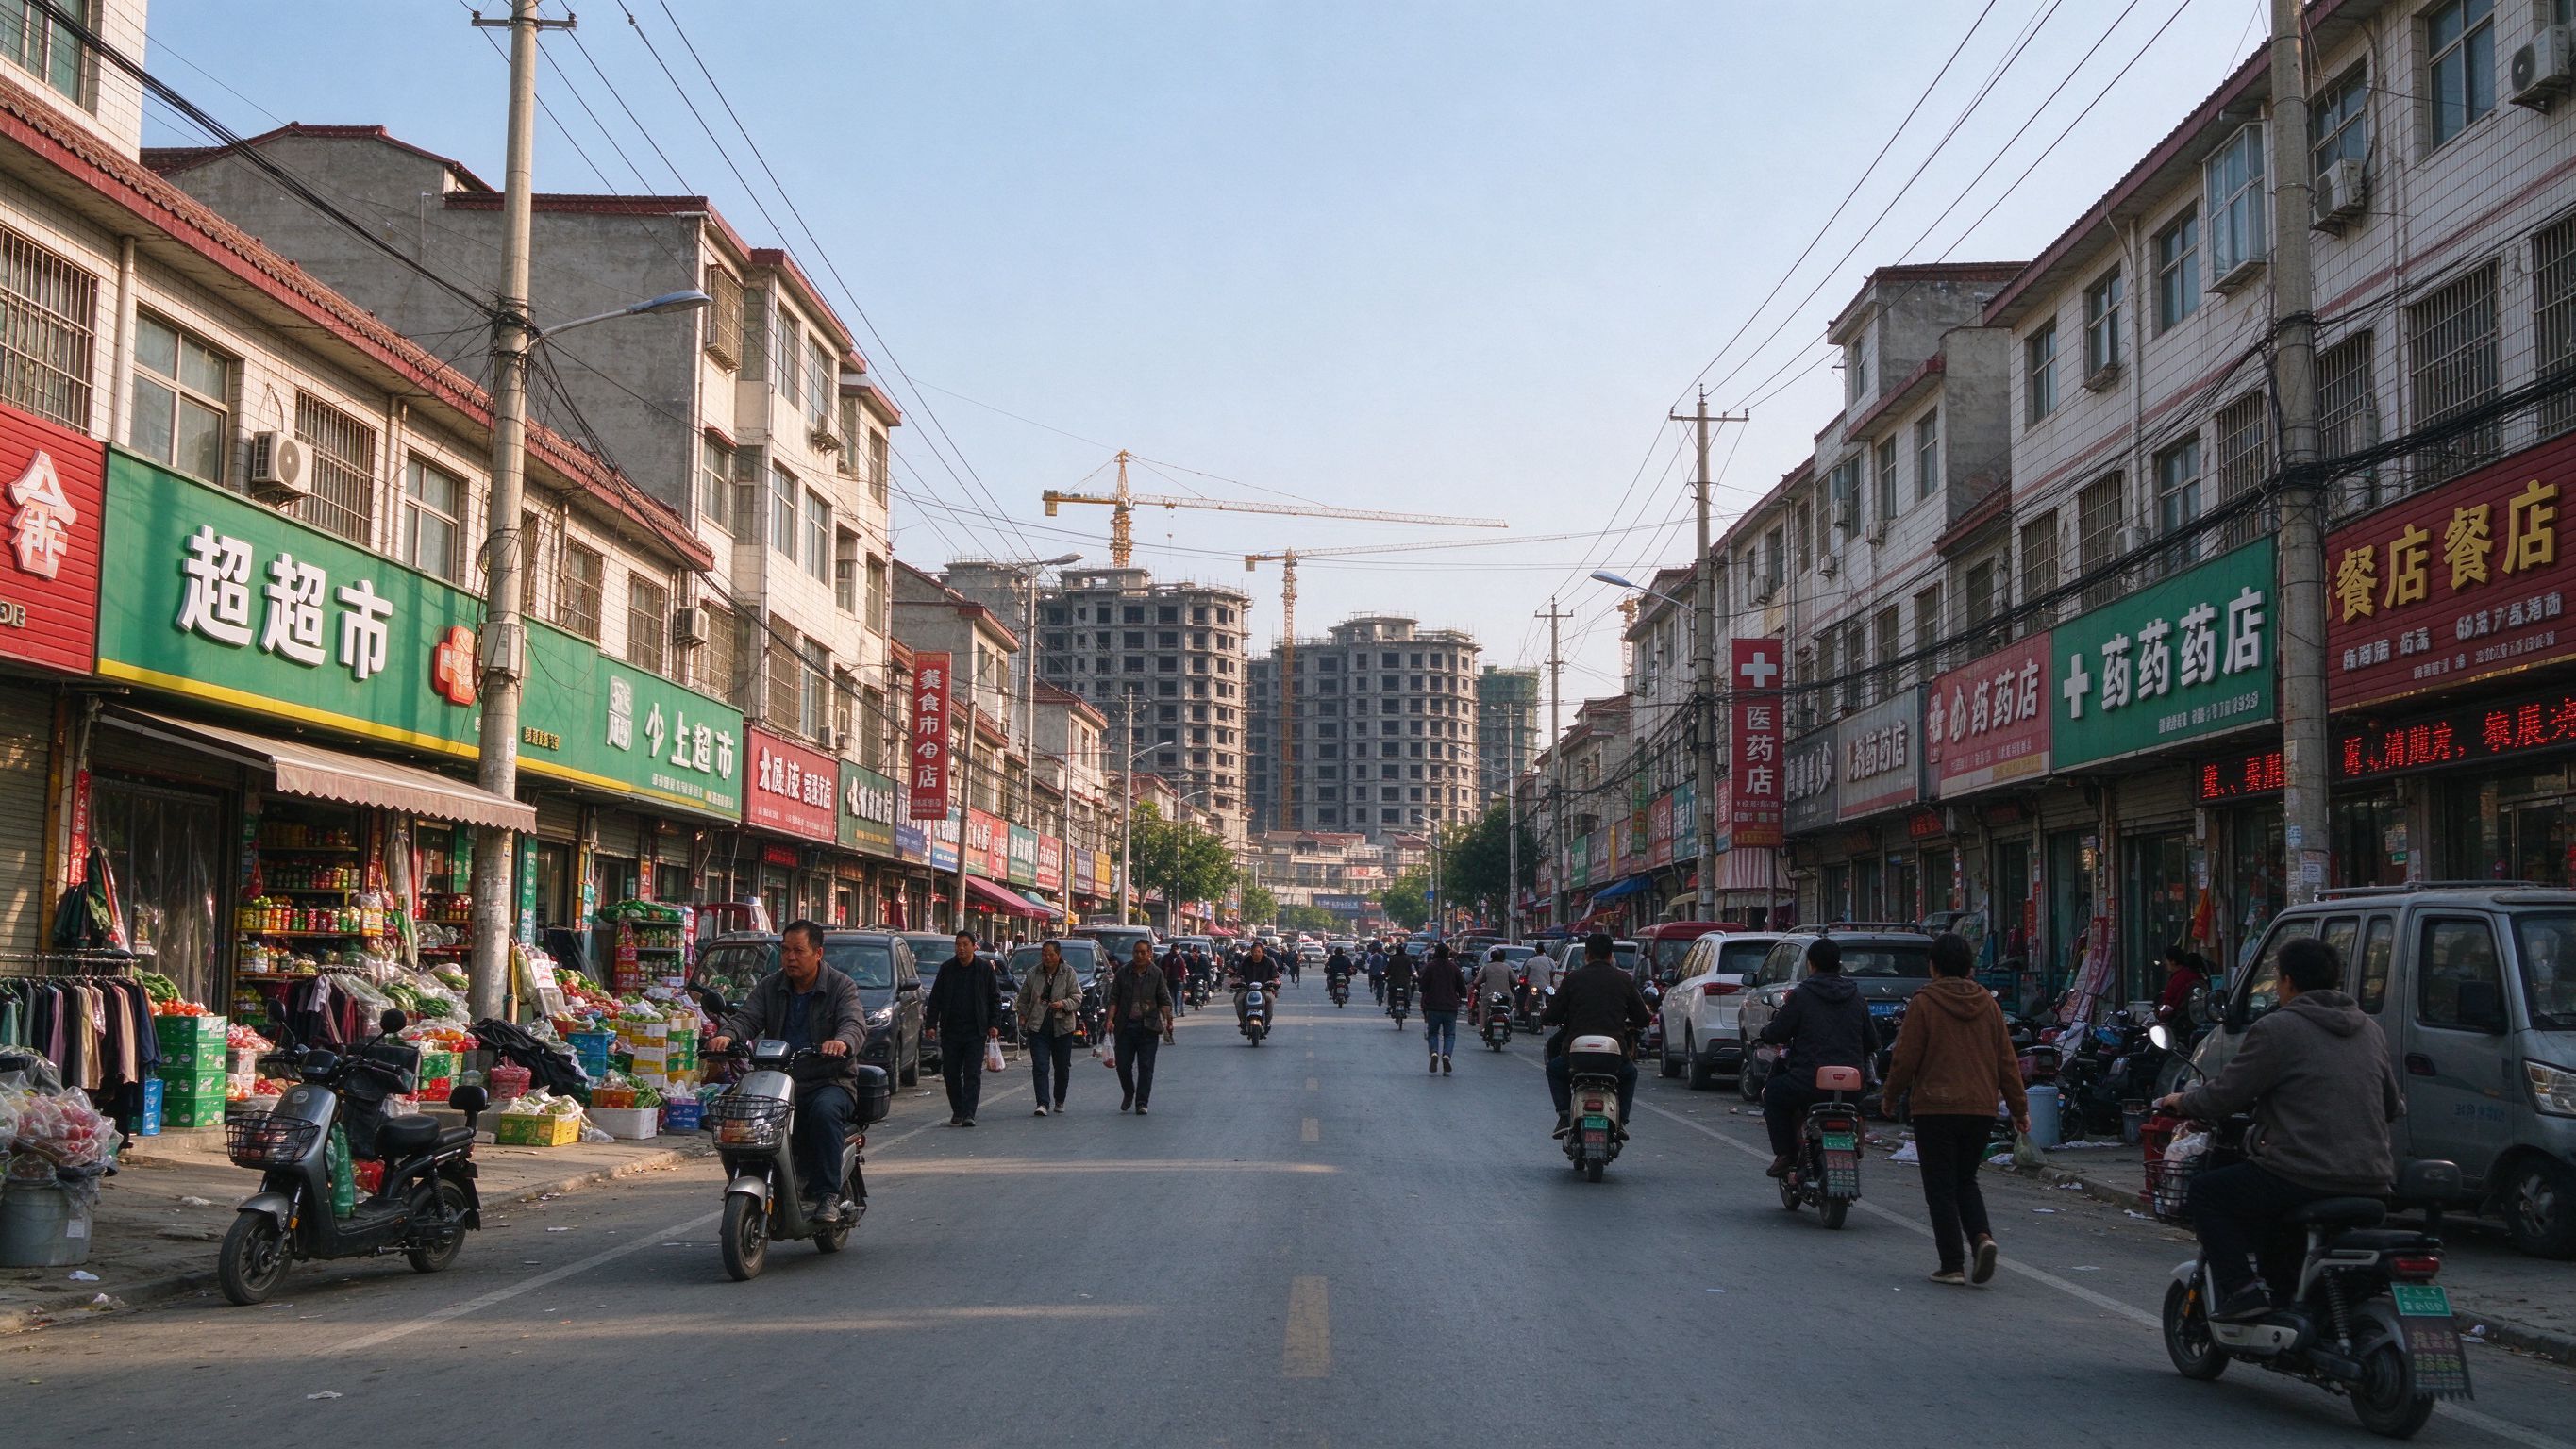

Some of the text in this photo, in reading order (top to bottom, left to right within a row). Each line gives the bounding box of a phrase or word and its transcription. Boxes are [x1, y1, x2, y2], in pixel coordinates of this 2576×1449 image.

[176, 525, 393, 680] 超超市
[2325, 479, 2559, 624] 餐店餐店
[2100, 586, 2266, 712] 药药药店
[1745, 706, 1775, 795] 医药店
